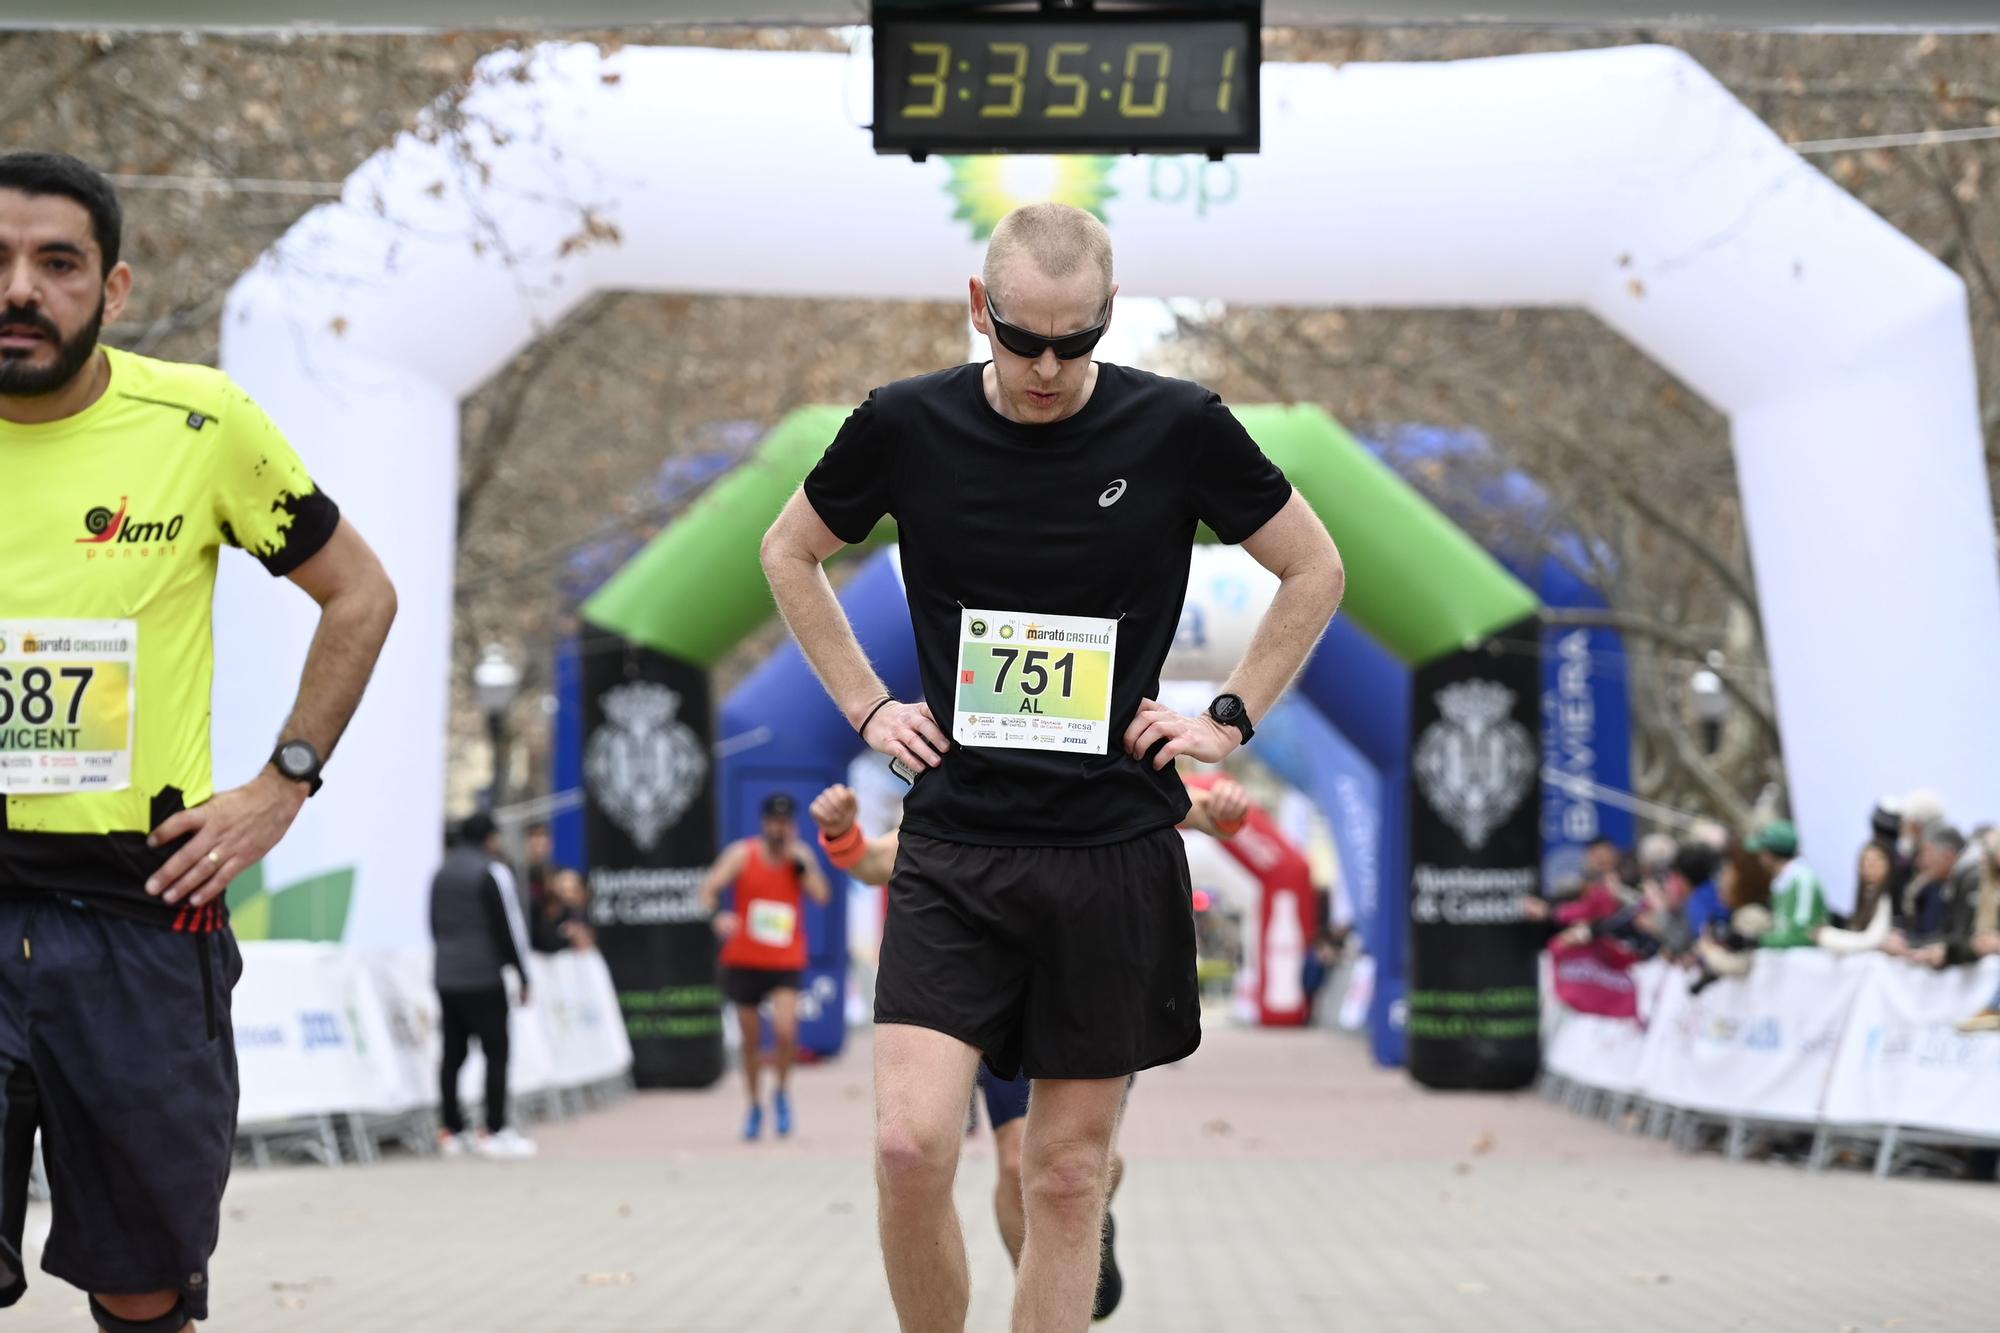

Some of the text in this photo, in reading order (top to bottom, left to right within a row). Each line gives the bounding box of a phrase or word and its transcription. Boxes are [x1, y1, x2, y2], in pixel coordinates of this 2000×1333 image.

[901, 42, 1237, 118] 3:35:01
[1148, 154, 1239, 217] bp
[1027, 628, 1109, 644] marató CASTELLÓ
[991, 648, 1074, 698] 751
[1019, 698, 1043, 713] AL
[0, 729, 80, 748] VICENT
